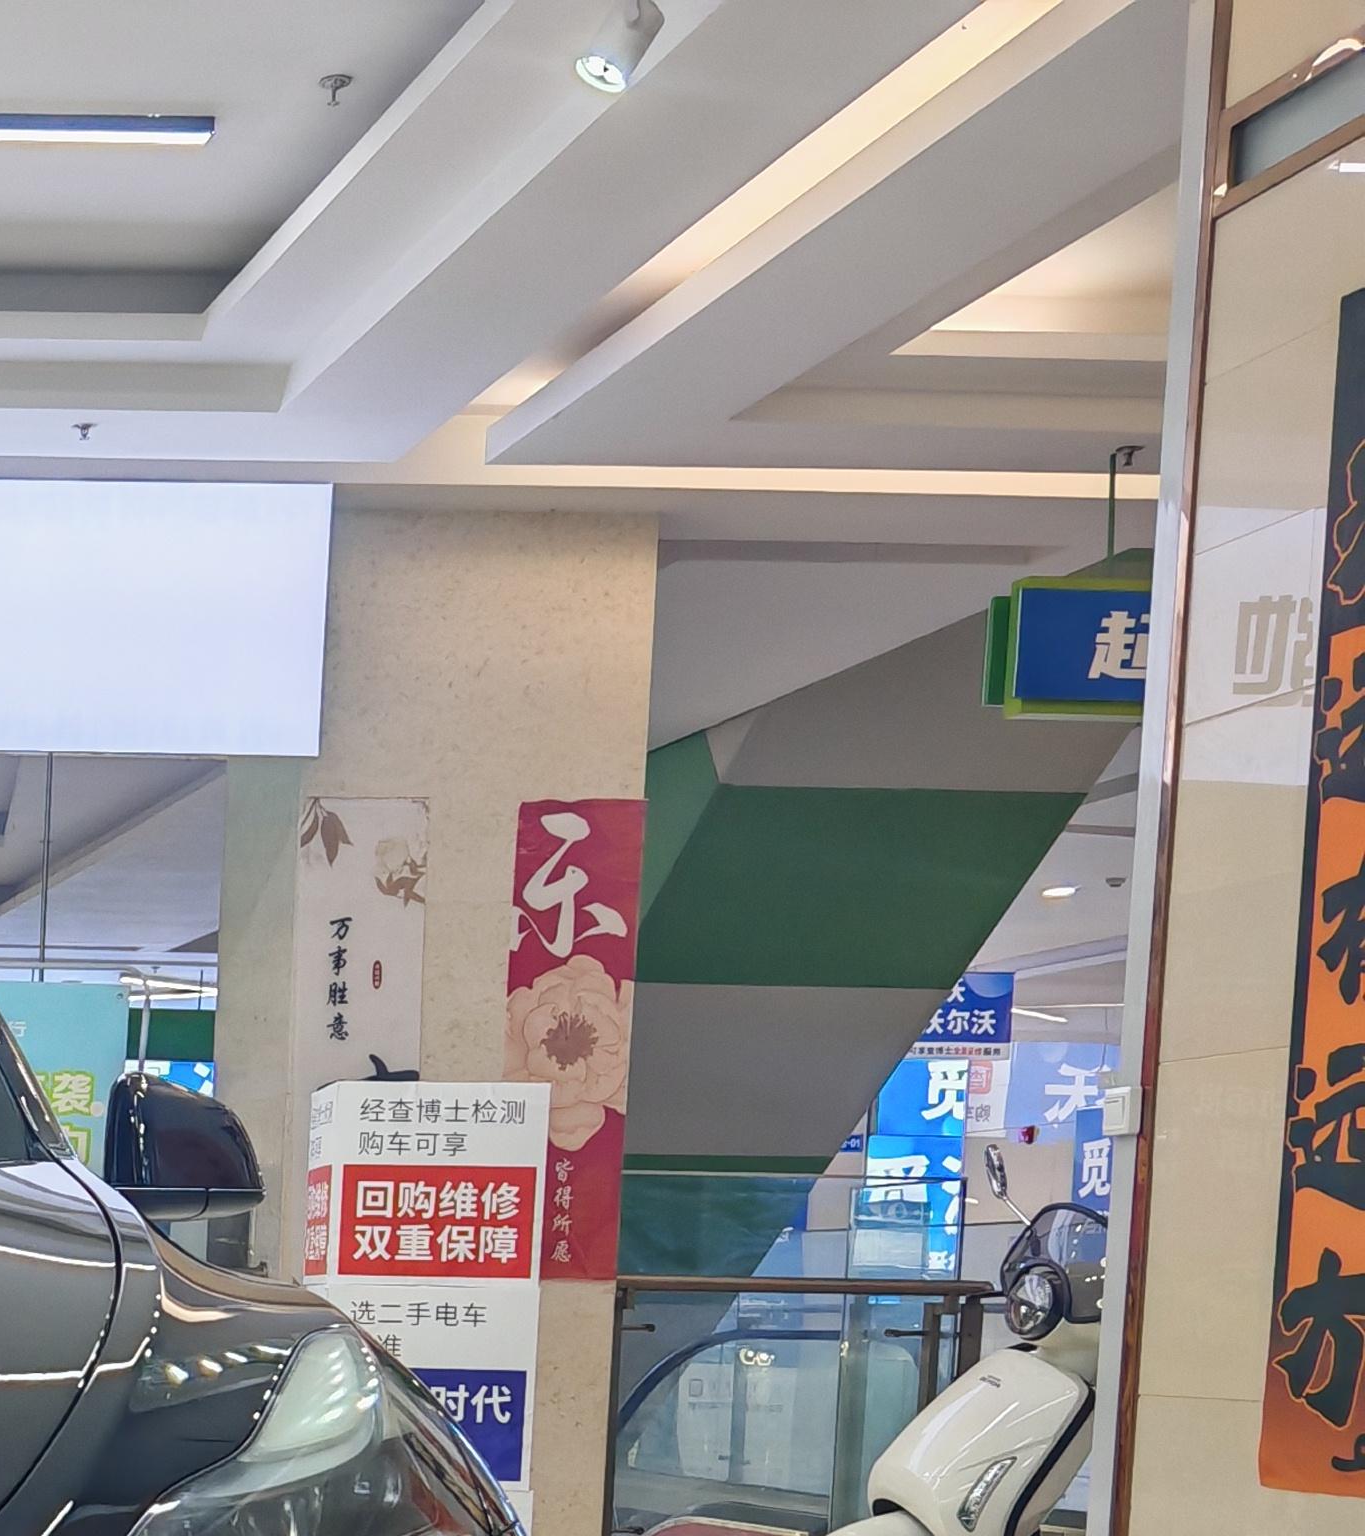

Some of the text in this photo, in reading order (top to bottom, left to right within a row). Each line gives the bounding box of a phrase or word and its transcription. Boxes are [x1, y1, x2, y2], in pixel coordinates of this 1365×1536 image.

[326, 916, 354, 1041] 万事胜意
[360, 1098, 526, 1126] 经查博士检测
[358, 1131, 468, 1157] 购车可享
[355, 1180, 521, 1222] 回购维修
[550, 1158, 575, 1263] 皆得所愿
[352, 1224, 520, 1264] 双重保障
[351, 1300, 487, 1328] 选二手电车
[430, 1384, 511, 1424] 时代
